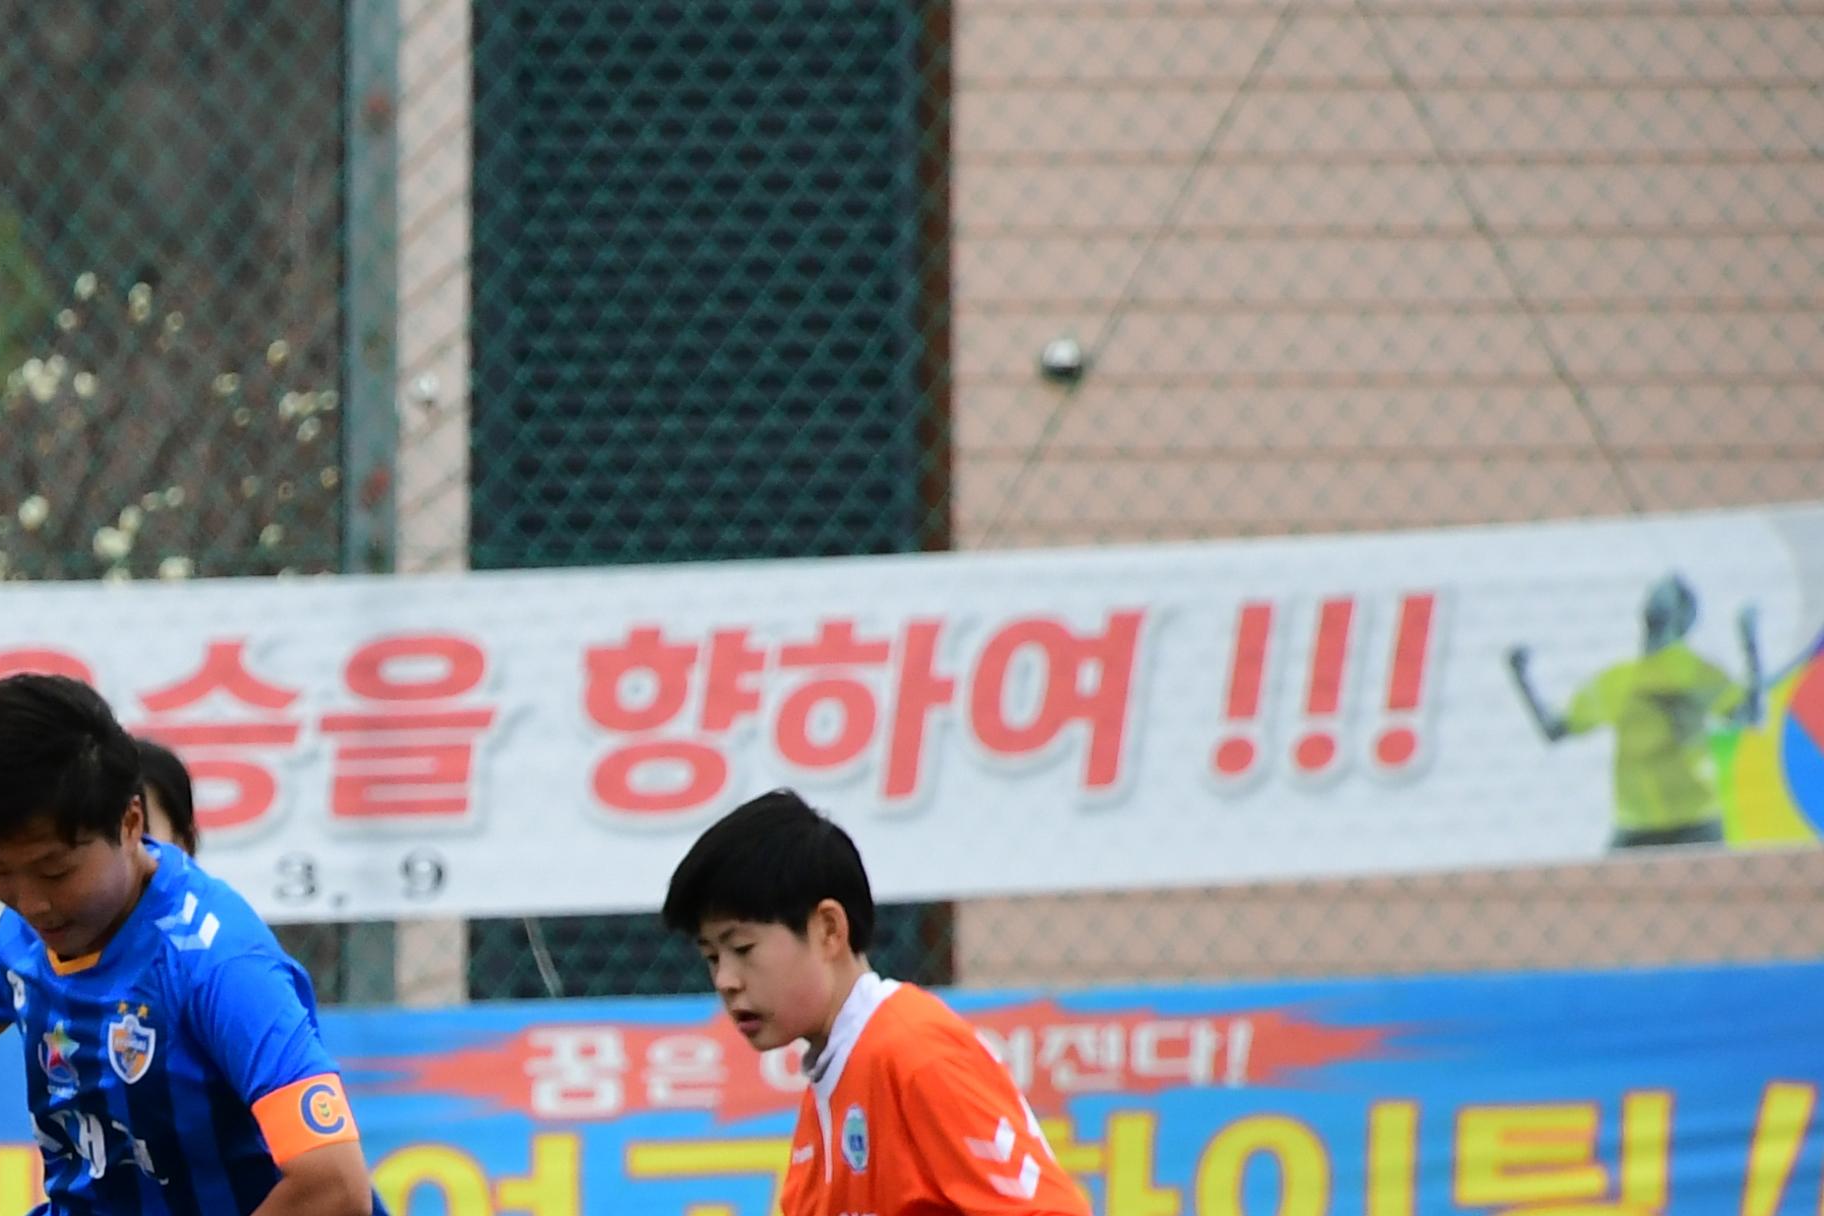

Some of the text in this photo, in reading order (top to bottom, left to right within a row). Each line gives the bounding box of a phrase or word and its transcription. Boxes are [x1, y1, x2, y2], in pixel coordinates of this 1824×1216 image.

[584, 610, 1144, 812] 향하여
[300, 1084, 345, 1134] C
[522, 1024, 728, 1120] 꿈은
